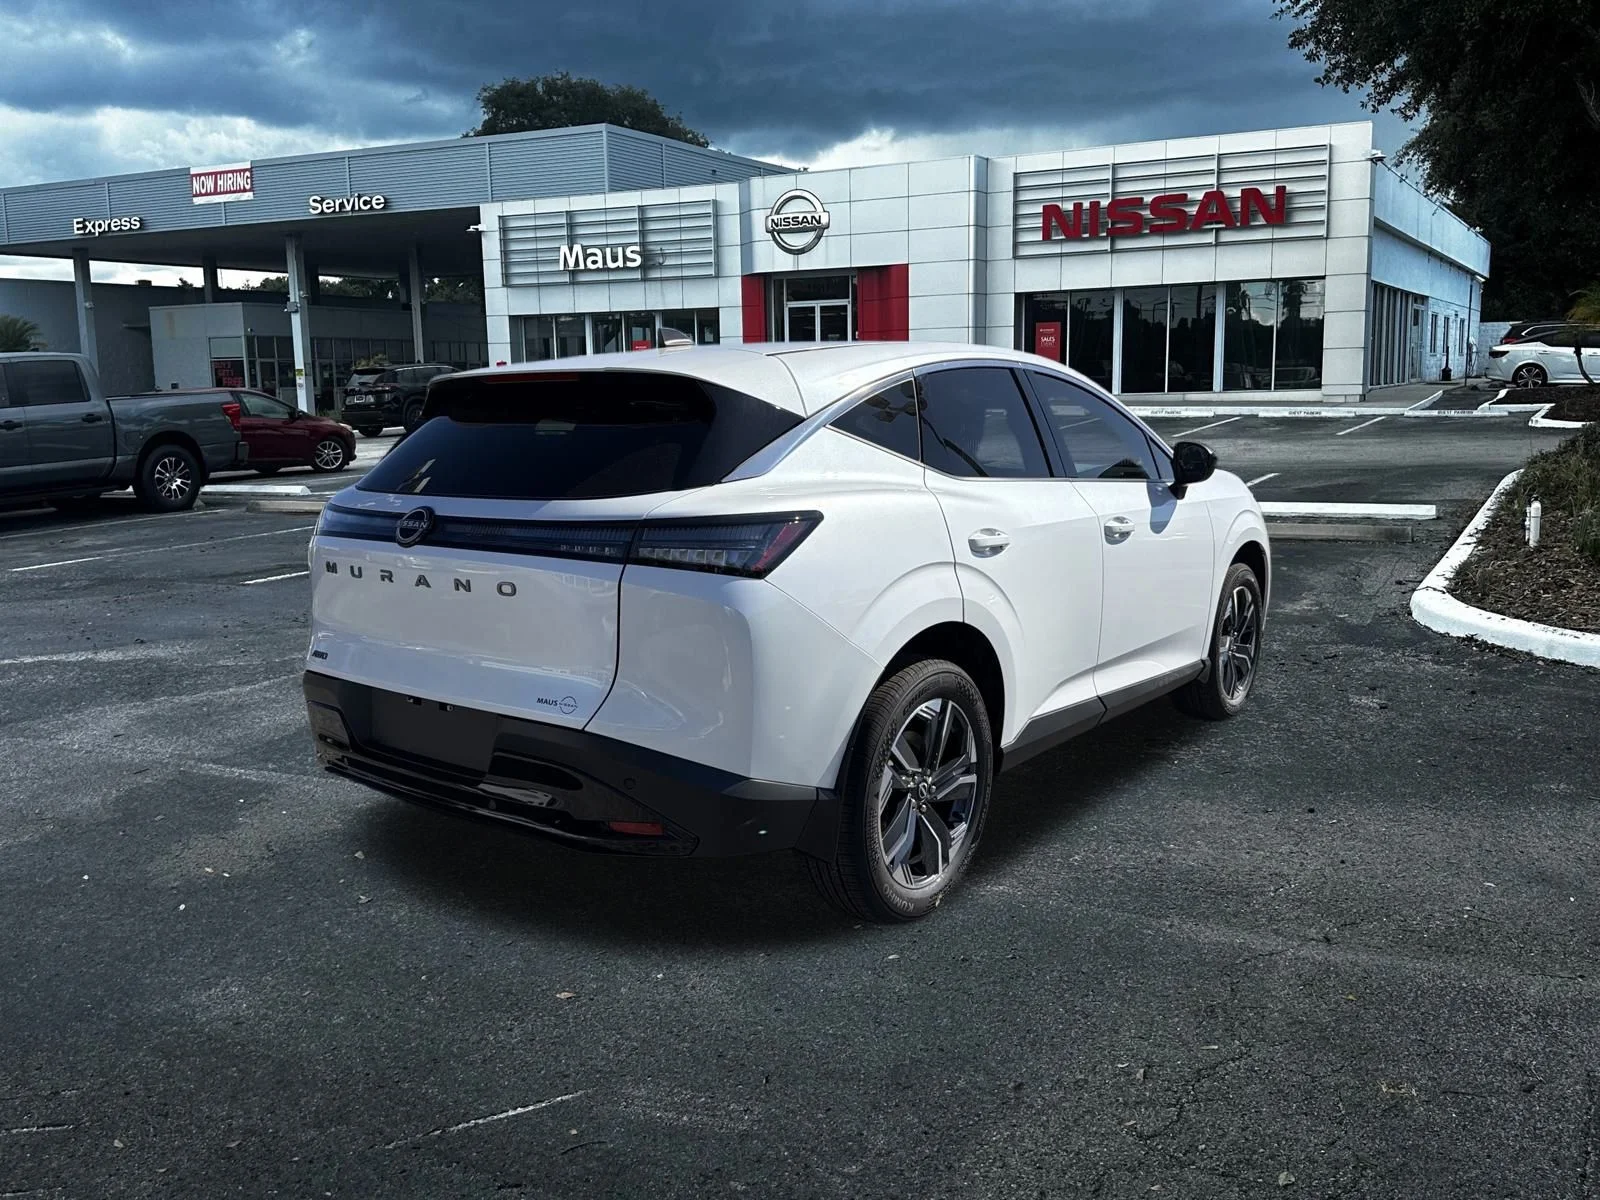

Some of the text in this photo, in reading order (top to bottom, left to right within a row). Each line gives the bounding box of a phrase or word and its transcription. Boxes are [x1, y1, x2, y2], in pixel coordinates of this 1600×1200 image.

[192, 171, 252, 195] NOW HIRING
[309, 193, 385, 214] Service
[1042, 185, 1287, 241] NISSAN
[73, 217, 141, 236] Express
[771, 215, 822, 228] NISSAN
[559, 243, 642, 271] Maus
[325, 560, 517, 597] MURANO
[536, 697, 558, 706] MAUS
[882, 883, 915, 912] KUMHO
